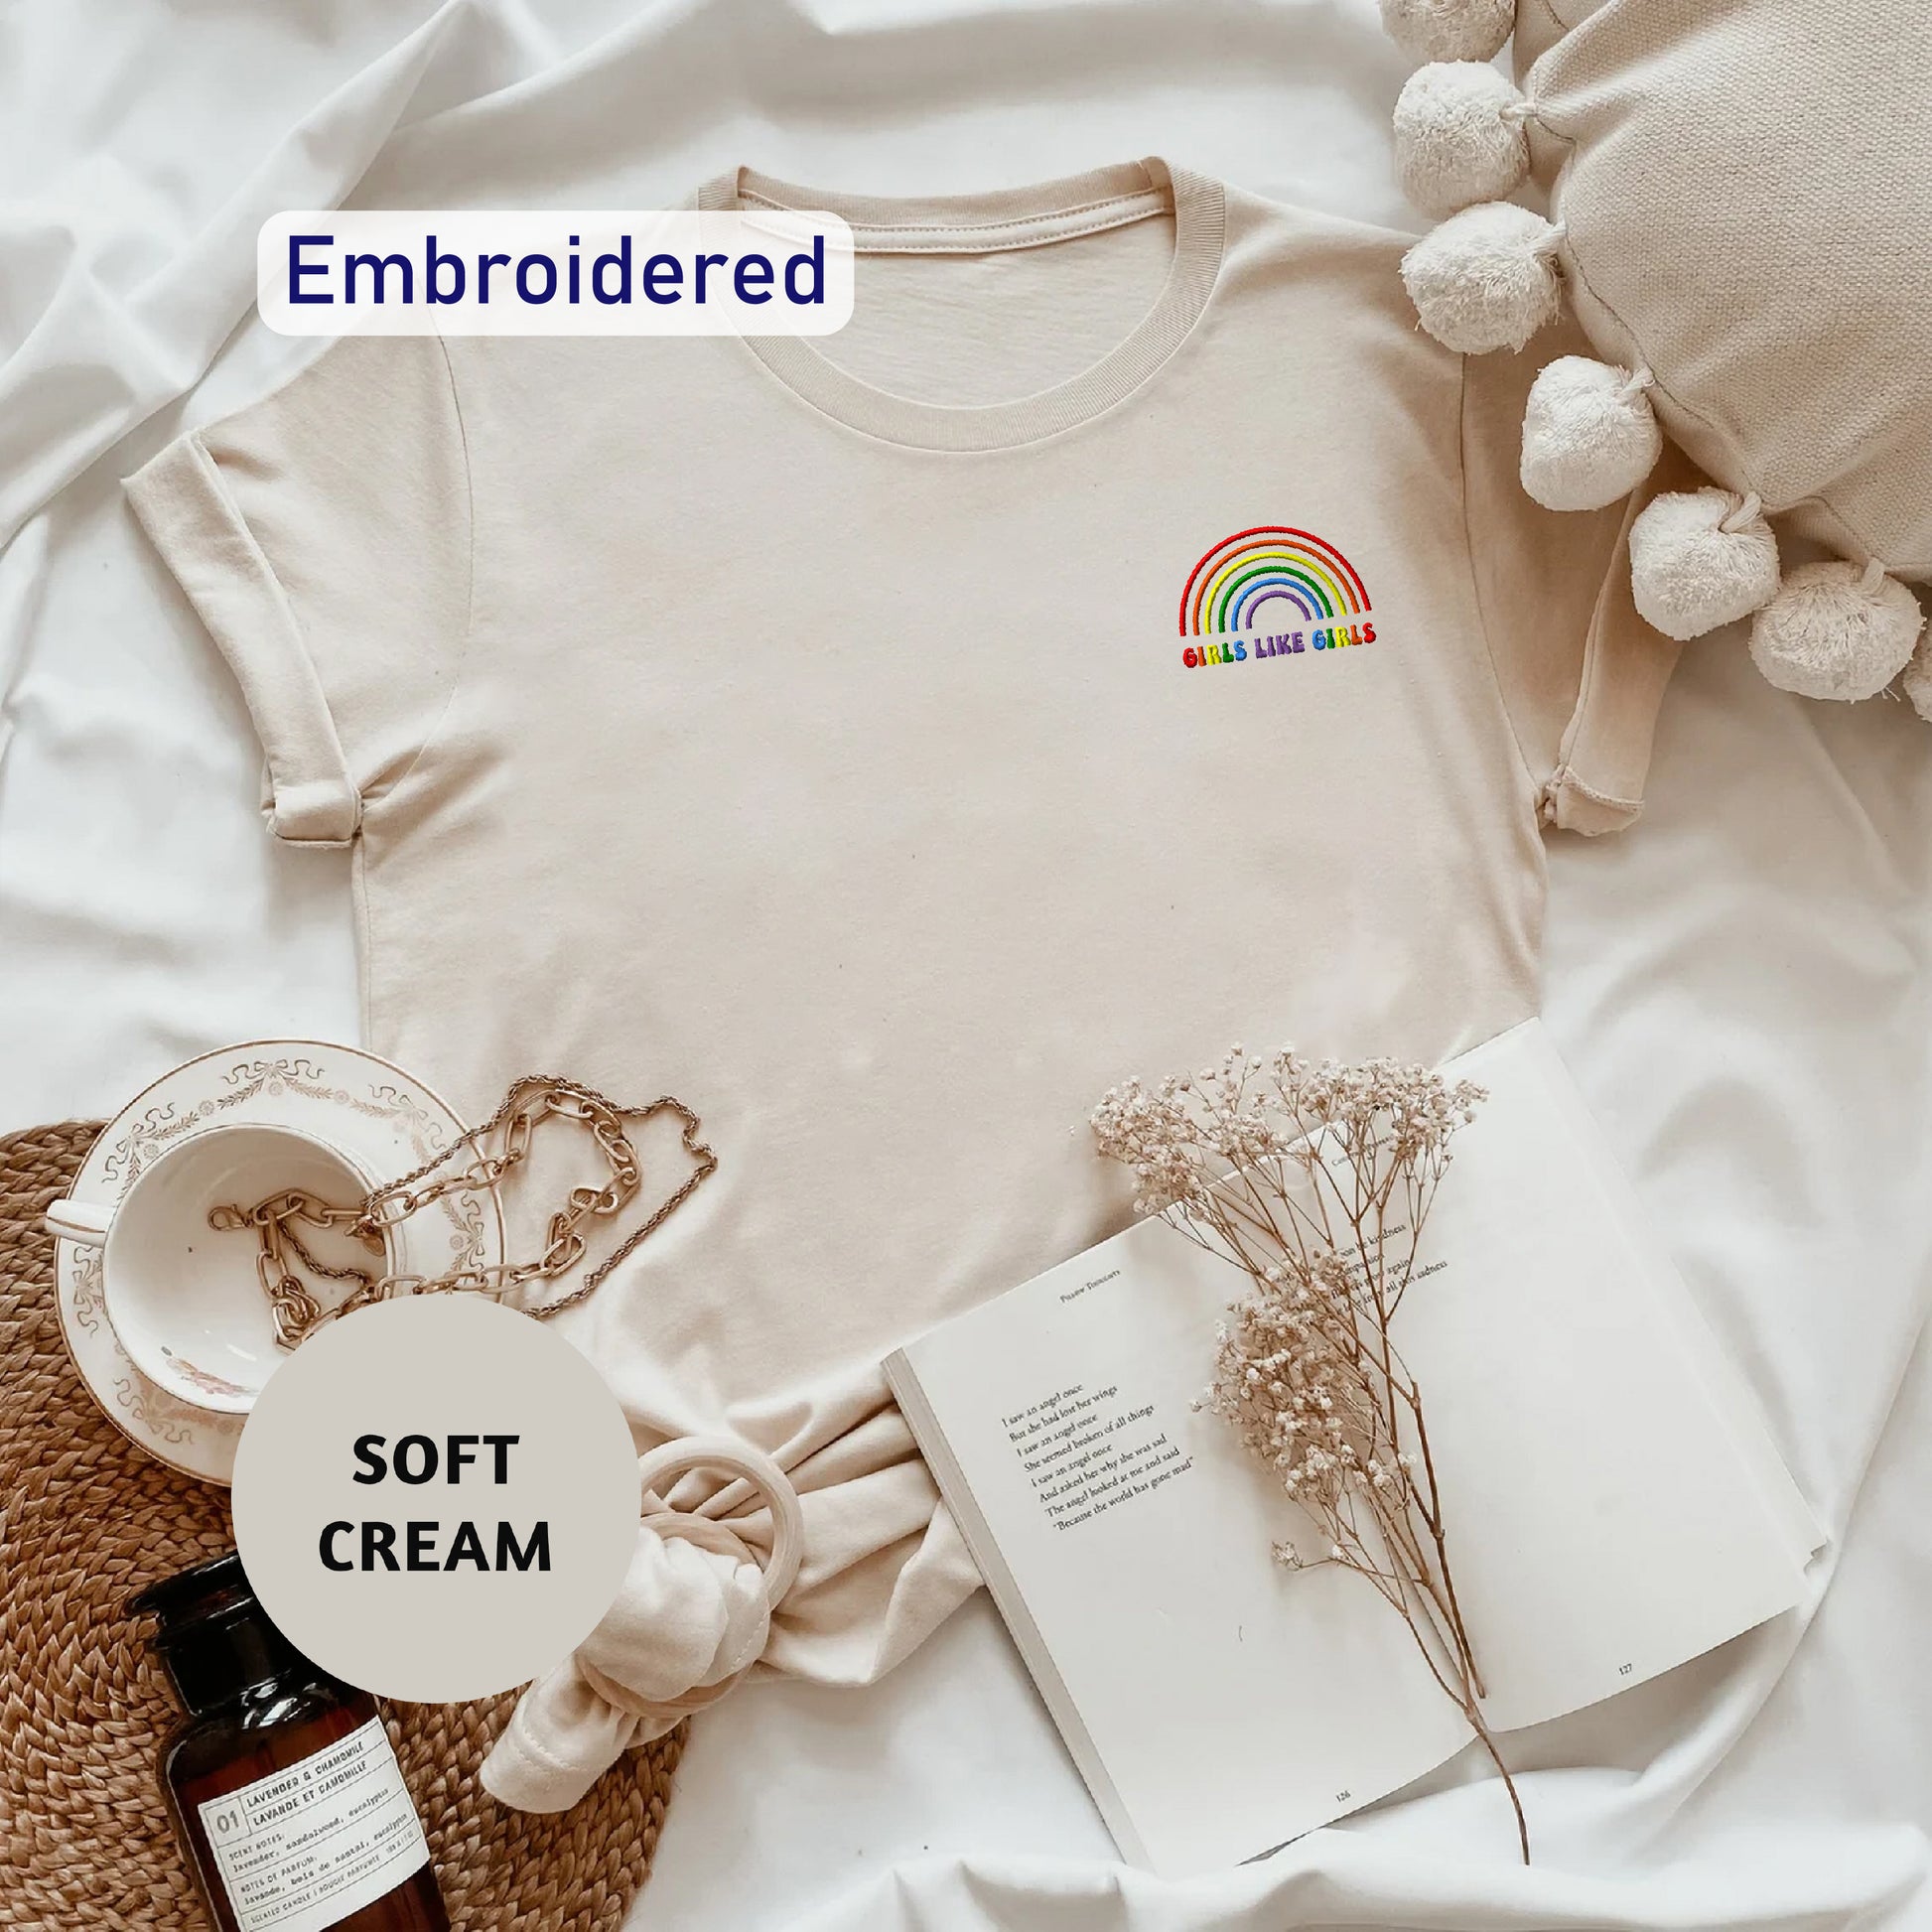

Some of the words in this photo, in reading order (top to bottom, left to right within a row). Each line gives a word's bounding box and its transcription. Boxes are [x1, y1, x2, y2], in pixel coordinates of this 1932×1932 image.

[1182, 640, 1247, 668] GIRLS
[1254, 631, 1306, 658] LIKE
[1311, 622, 1376, 650] GIRLS
[1009, 1413, 1024, 1424] saw
[1039, 1392, 1060, 1410] angel
[1040, 1412, 1059, 1426] had
[1074, 1398, 1091, 1410] her
[1024, 1460, 1040, 1471] She
[1115, 1416, 1126, 1429] all
[1053, 1422, 1075, 1440] angel
[1039, 1486, 1058, 1502] And
[1082, 1469, 1098, 1480] her
[1099, 1459, 1117, 1471] why
[1119, 1452, 1133, 1463] she
[1152, 1433, 1167, 1448] sad
[1068, 1451, 1091, 1470] angel
[1043, 1504, 1064, 1517] The
[1065, 1490, 1088, 1508] angel
[1087, 1475, 1118, 1496] looked
[1145, 1454, 1161, 1470] and
[1162, 1446, 1179, 1460] said
[1092, 1502, 1107, 1513] the
[1108, 1487, 1133, 1505] world
[1132, 1482, 1149, 1493] has
[1619, 1663, 1632, 1675] 127
[246, 1777, 299, 1808] LAVENDER
[315, 1741, 363, 1774] CHAMOMILE
[253, 1798, 299, 1825] LAVANDE
[302, 1789, 314, 1802] ET
[318, 1760, 365, 1793] CAMOMILLE
[216, 1810, 238, 1833] 01
